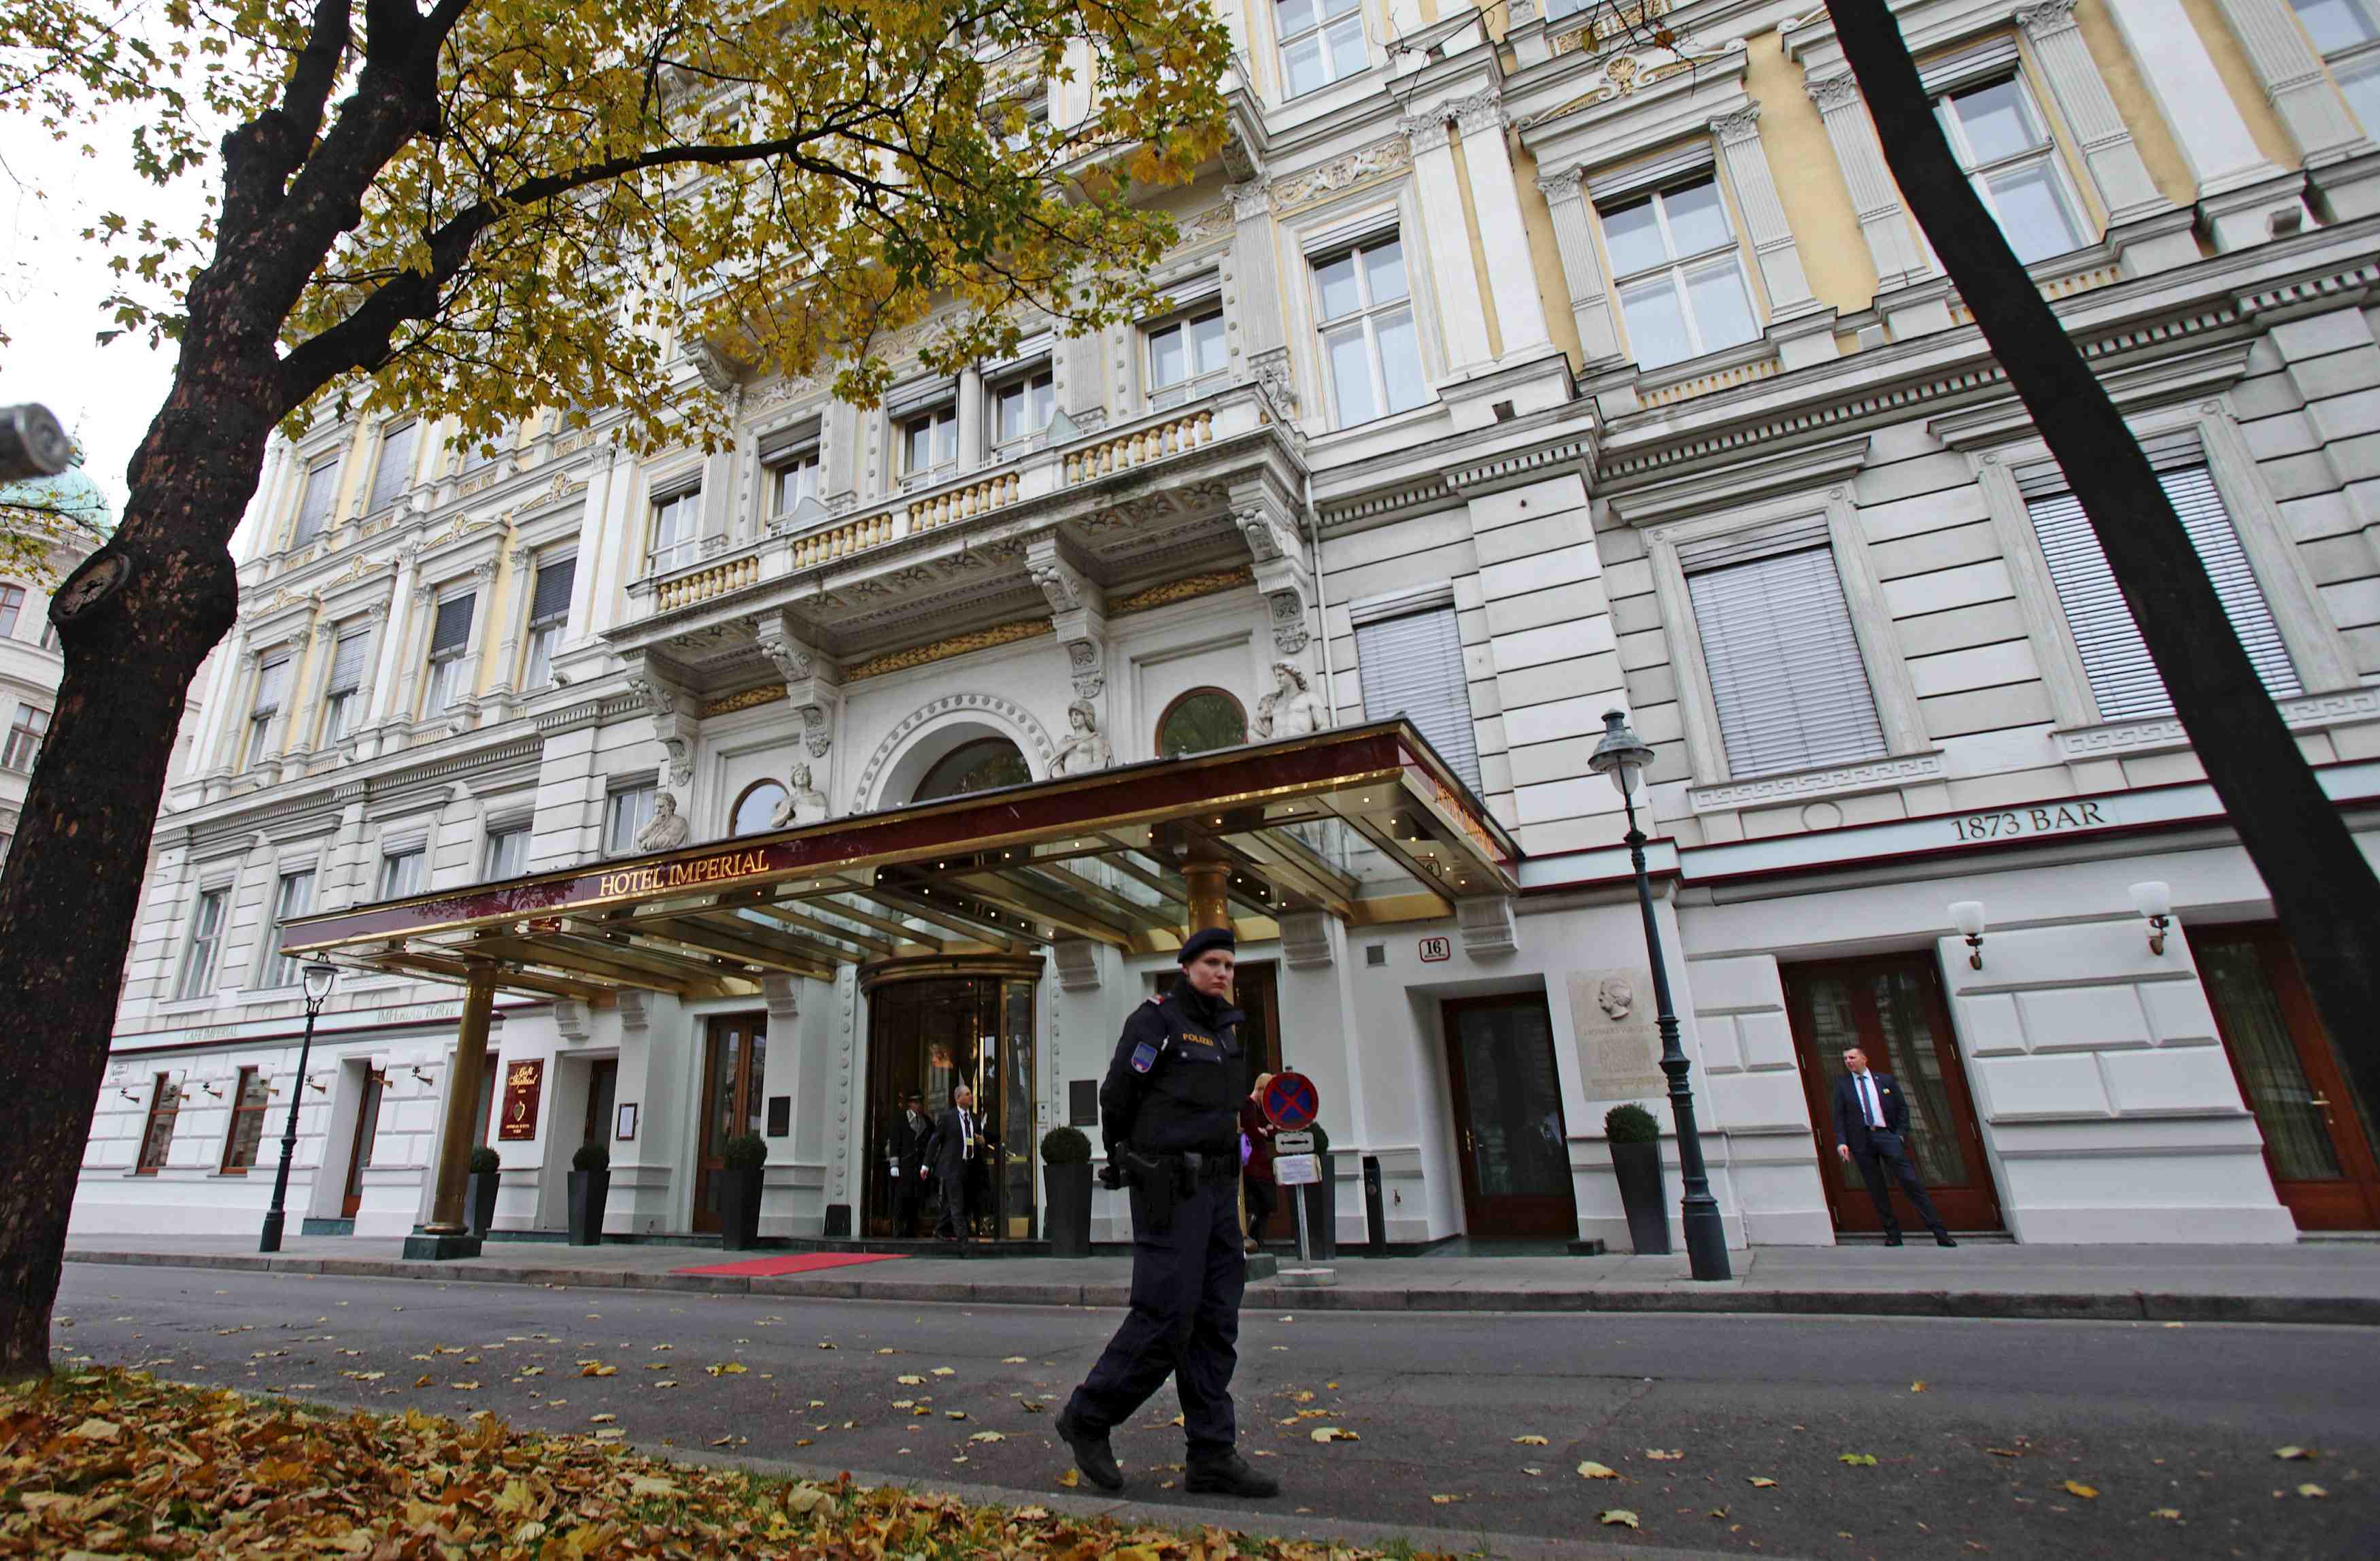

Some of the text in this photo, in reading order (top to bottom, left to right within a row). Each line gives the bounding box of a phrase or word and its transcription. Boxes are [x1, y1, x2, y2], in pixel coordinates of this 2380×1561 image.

[1951, 802, 2105, 841] 1873 BAR
[598, 850, 770, 897] HOTEL IMPERIAL
[1427, 941, 1441, 954] 16
